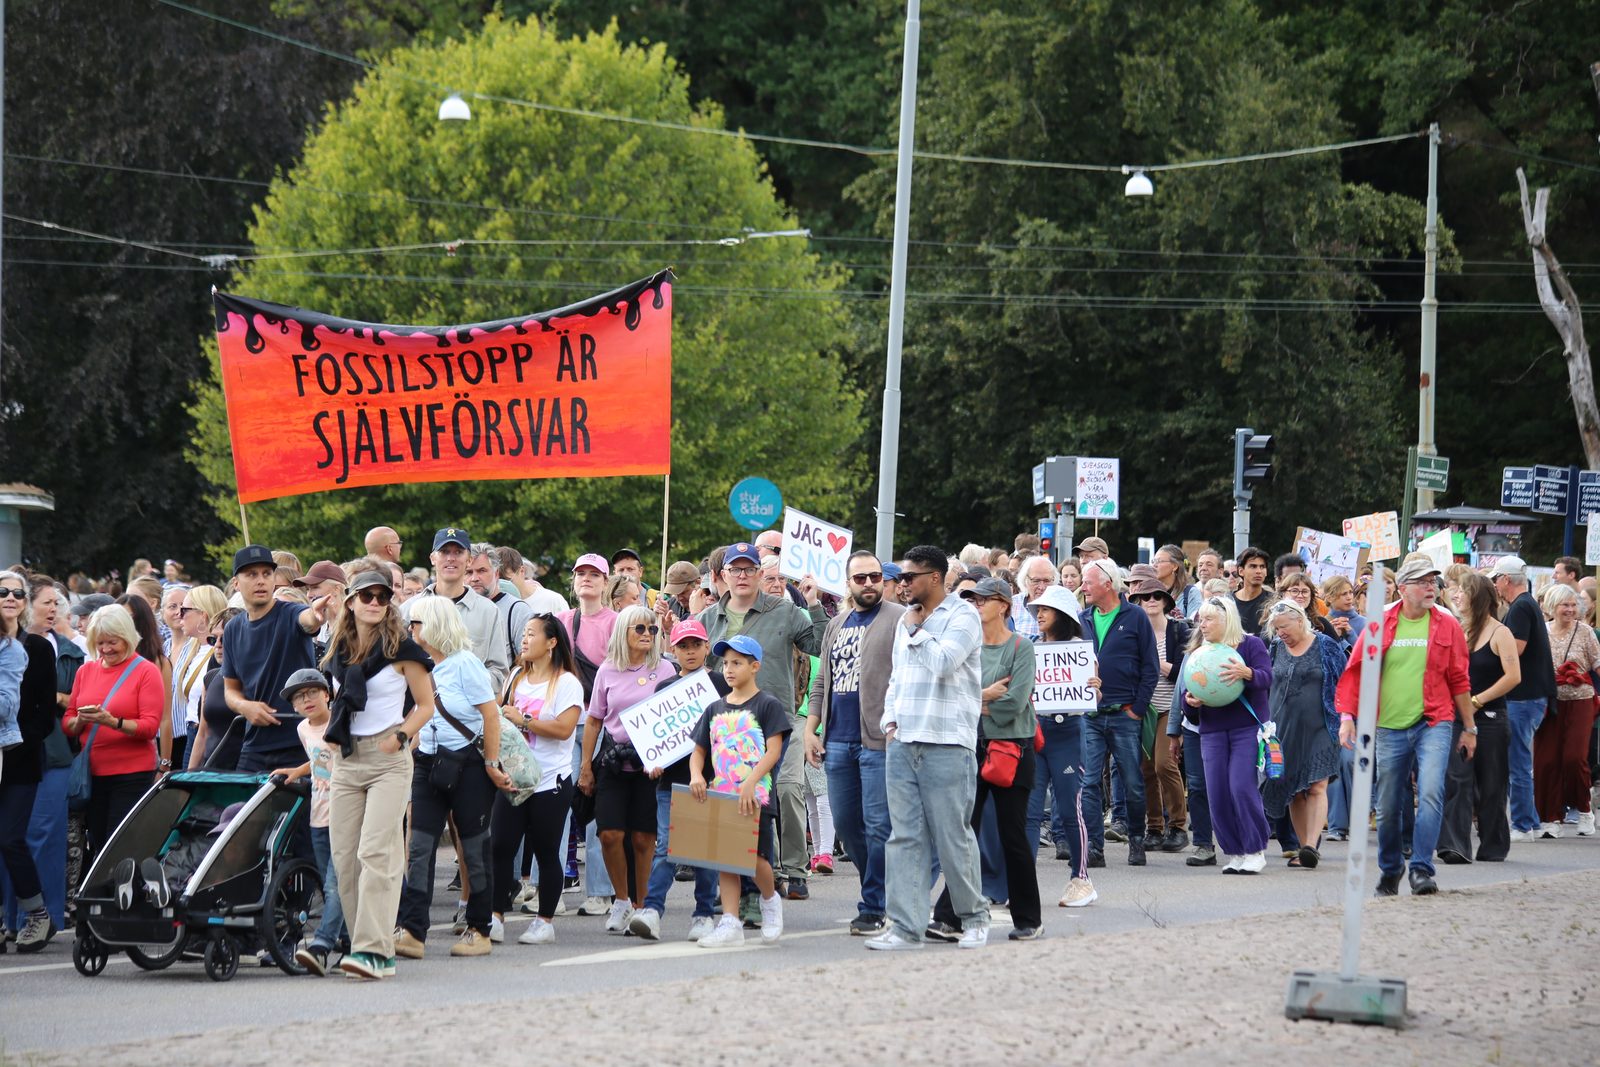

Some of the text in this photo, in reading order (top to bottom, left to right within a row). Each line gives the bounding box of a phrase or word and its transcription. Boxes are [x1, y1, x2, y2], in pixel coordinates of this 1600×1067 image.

[292, 330, 598, 397] FOSSILSTOPP ÄR
[312, 392, 591, 485] SJÄLVFÖRSVAR
[739, 490, 760, 505] styr
[740, 503, 773, 515] &ställ
[790, 520, 822, 548] JAG
[787, 544, 842, 584] SNÖ
[1044, 650, 1089, 667] FINNS
[629, 682, 707, 729] VI VILL HA
[1042, 685, 1094, 702] CHANS
[652, 700, 704, 738] GRÖN
[646, 722, 697, 761] OMSTÄ
